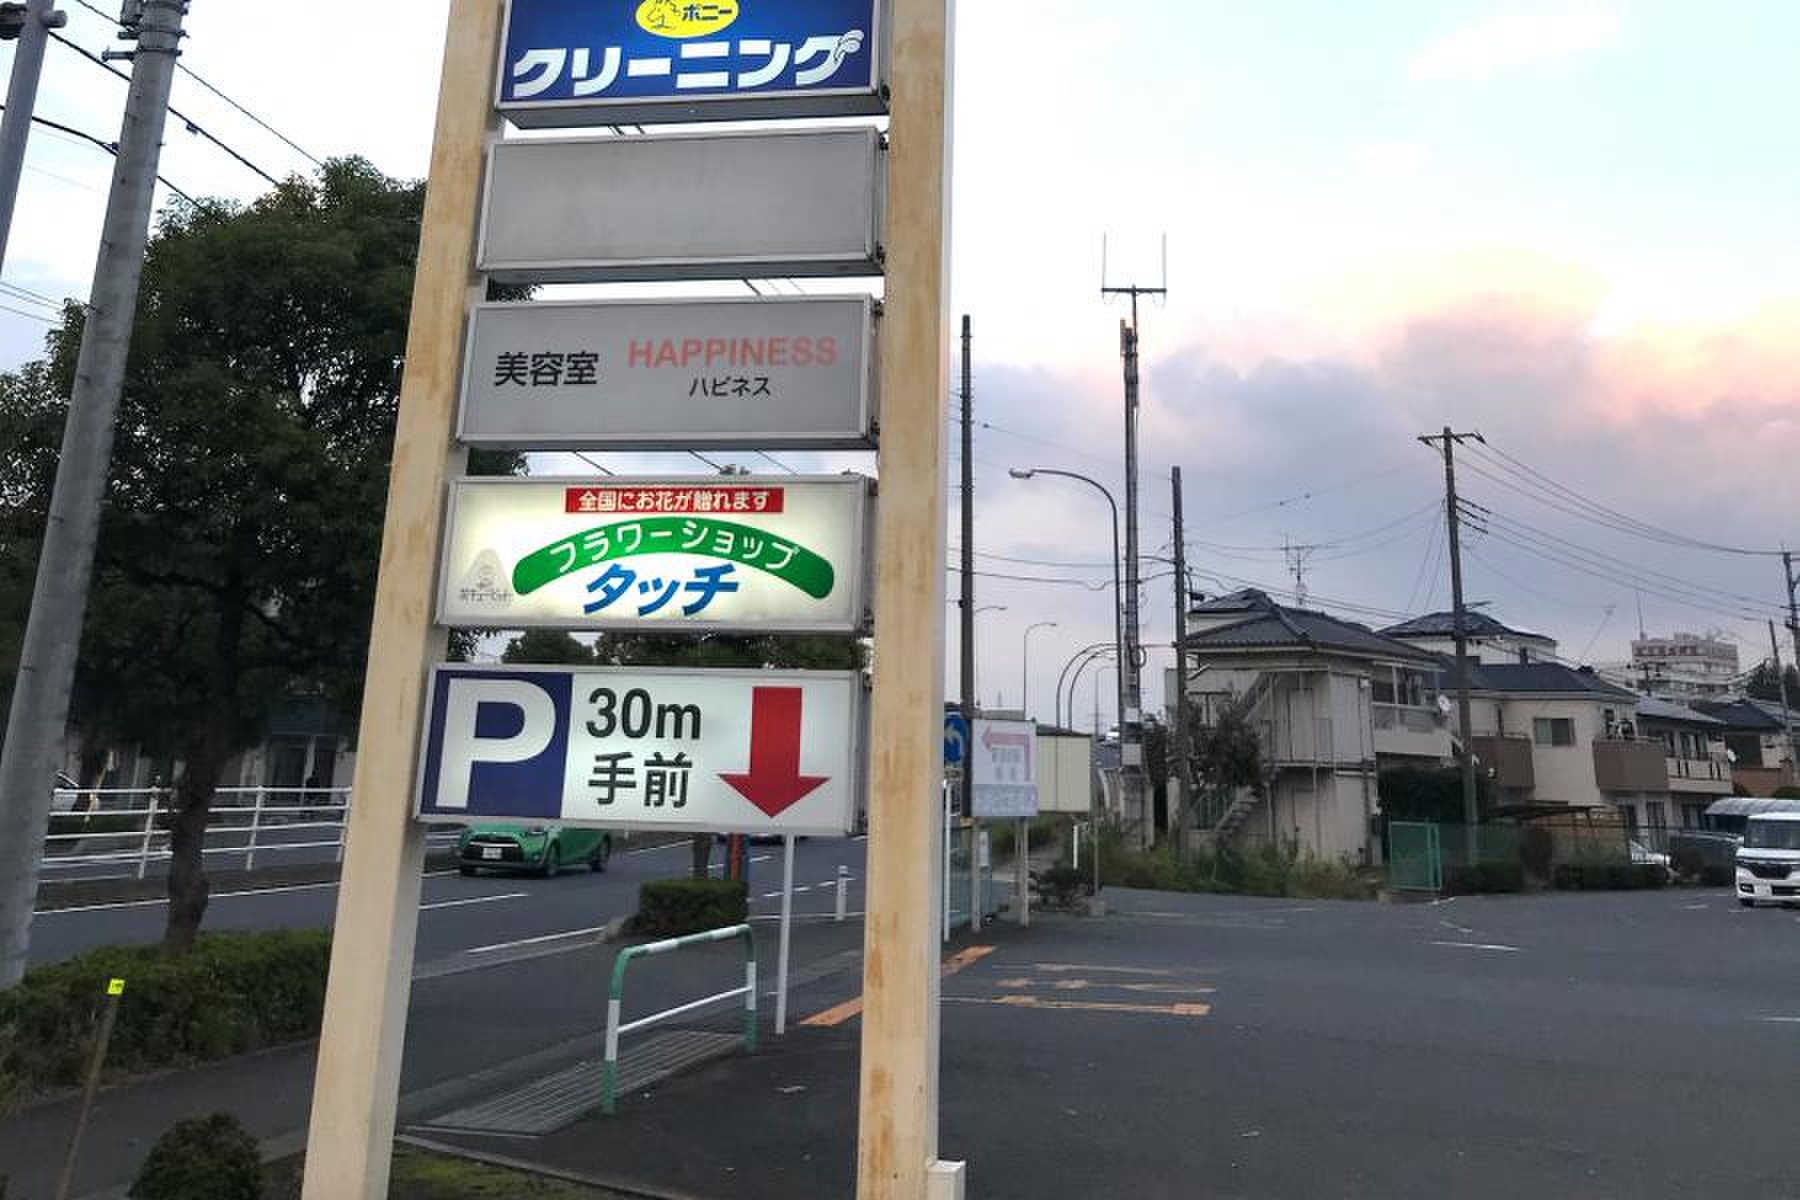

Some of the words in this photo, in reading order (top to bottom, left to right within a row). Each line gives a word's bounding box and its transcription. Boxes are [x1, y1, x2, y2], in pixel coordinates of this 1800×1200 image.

[513, 29, 865, 97] クリーニング
[495, 351, 600, 387] 美容室
[628, 336, 841, 368] HAPPINESS
[578, 491, 770, 511] 全国にお花が贈れます
[550, 520, 800, 572] フラワーショップ
[583, 563, 738, 616] タッチ
[586, 687, 701, 740] 30m
[435, 678, 556, 808] P
[588, 751, 693, 808] 手前
